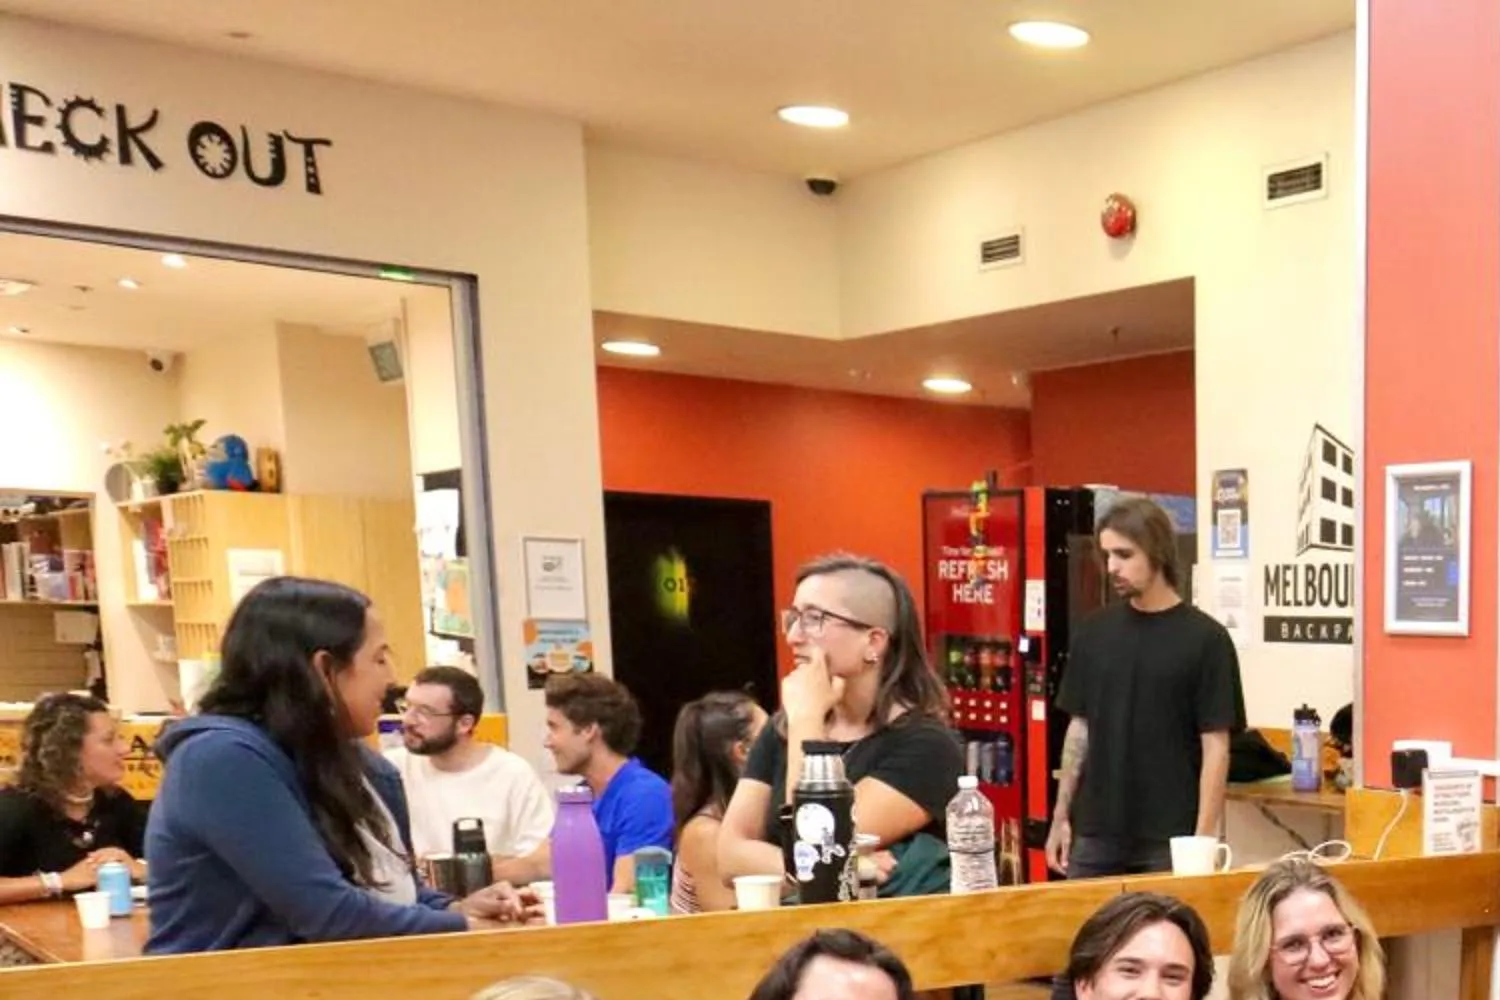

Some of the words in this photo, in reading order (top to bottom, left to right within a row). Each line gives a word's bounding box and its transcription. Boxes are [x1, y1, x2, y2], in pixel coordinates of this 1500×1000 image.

[0, 82, 165, 172] ECK
[187, 120, 333, 195] OUT
[938, 559, 1009, 581] REFRSH
